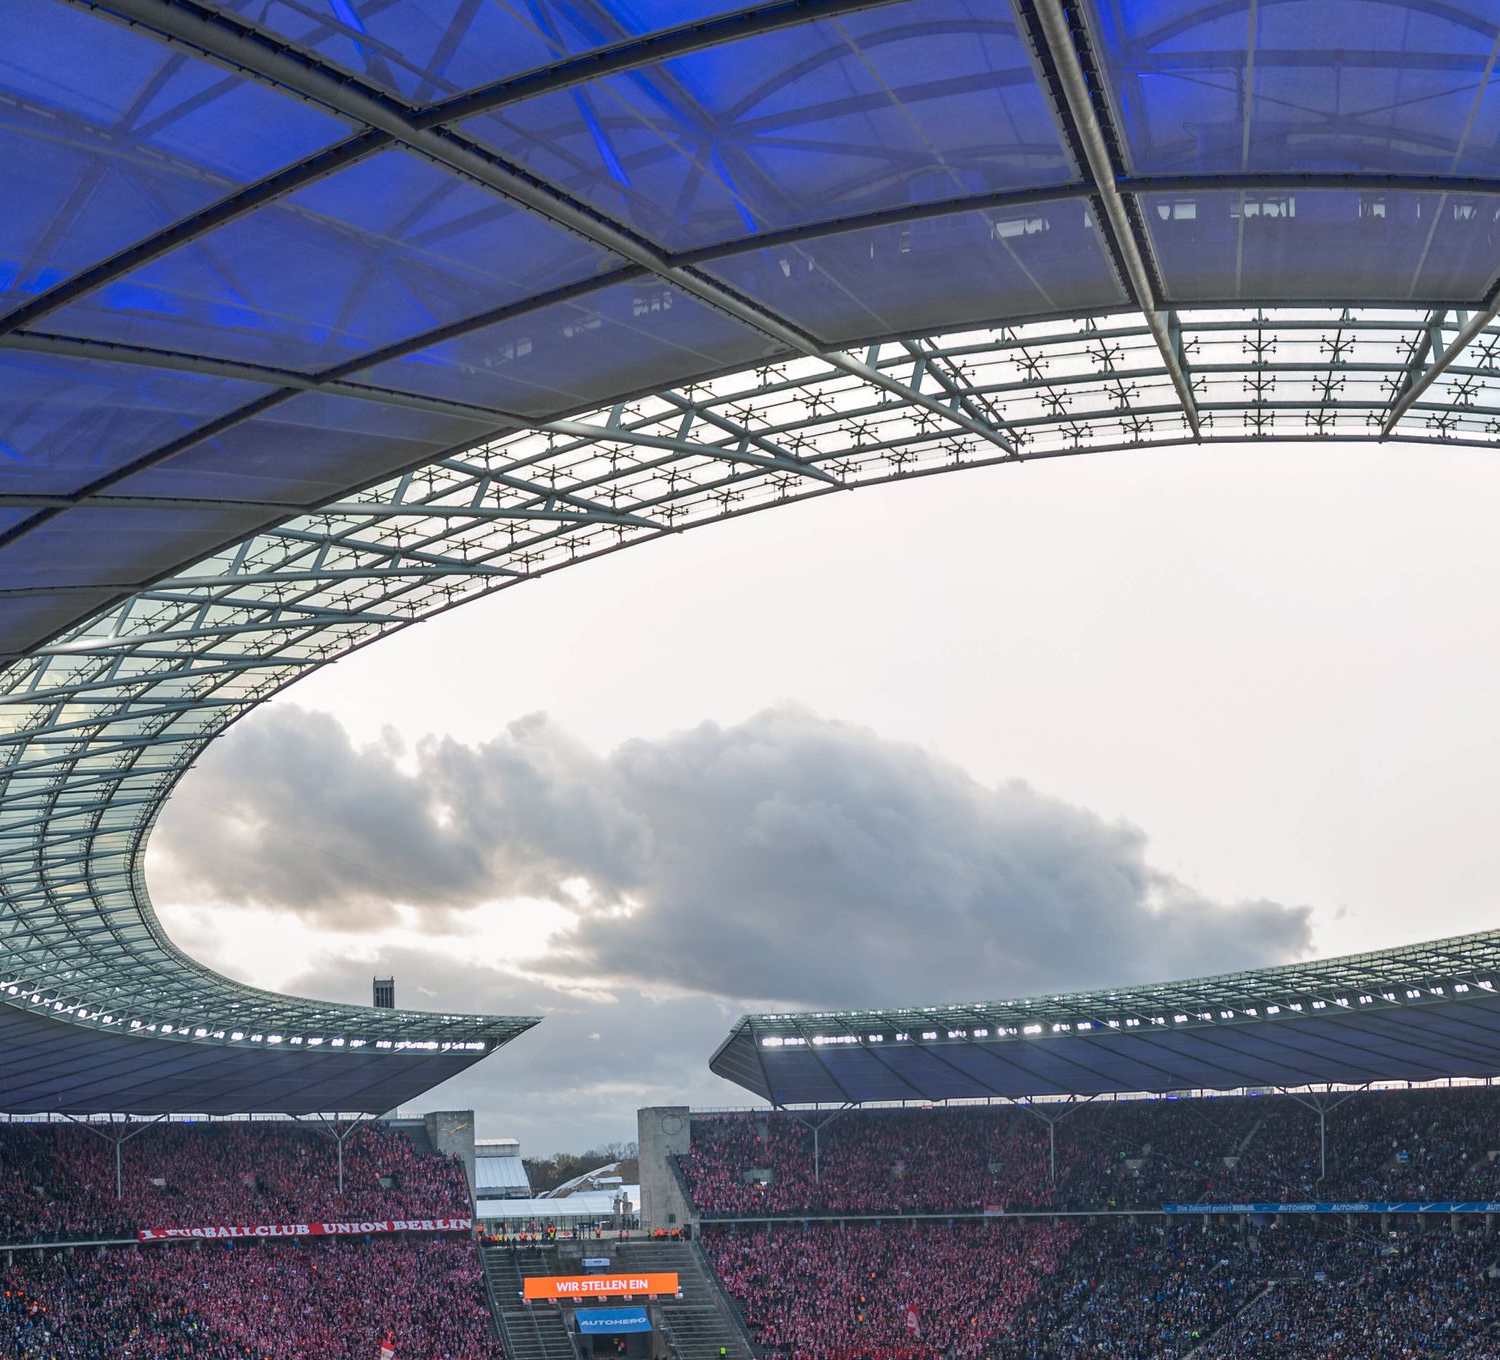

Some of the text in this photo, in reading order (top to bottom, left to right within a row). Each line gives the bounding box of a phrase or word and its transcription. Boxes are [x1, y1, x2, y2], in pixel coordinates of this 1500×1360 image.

[323, 1221, 391, 1234] UNION
[393, 1217, 472, 1232] BERLIN
[556, 1279, 649, 1292] WIR STELLEN EIN
[581, 1317, 647, 1326] AUTOHERO
